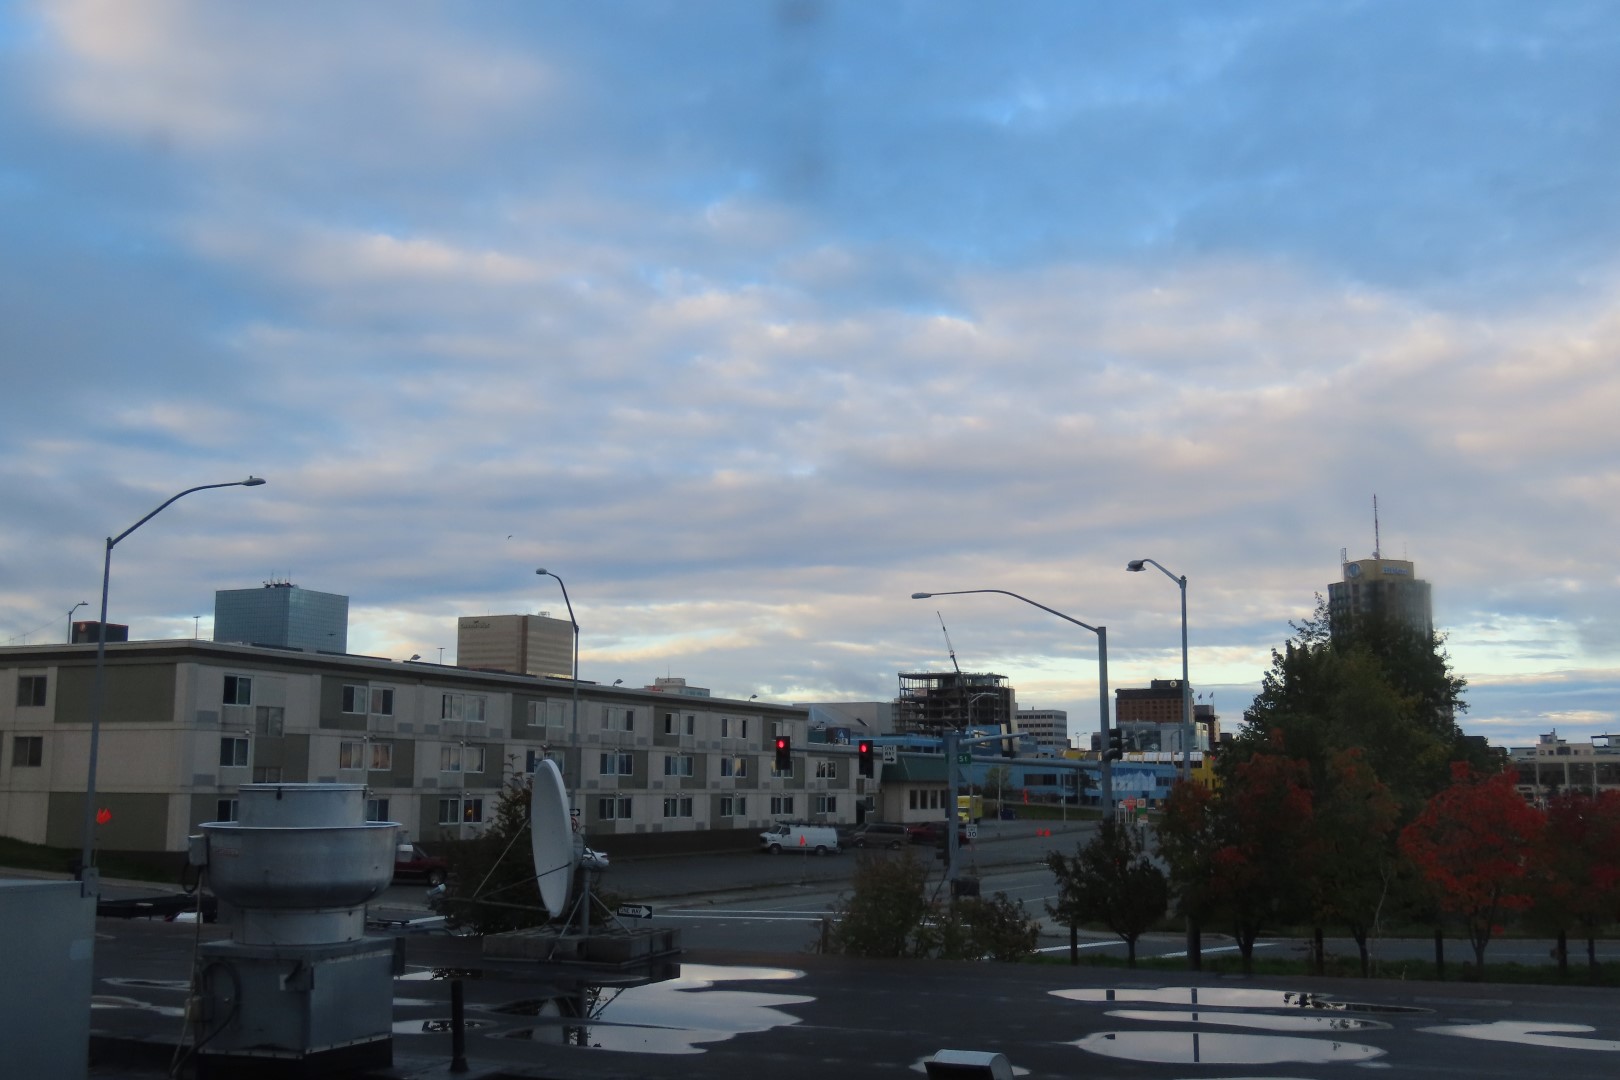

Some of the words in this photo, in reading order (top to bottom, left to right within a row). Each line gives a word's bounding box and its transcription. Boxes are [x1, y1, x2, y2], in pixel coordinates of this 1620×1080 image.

[959, 755, 968, 763] St
[619, 906, 630, 914] ONE
[631, 907, 642, 915] WAY
